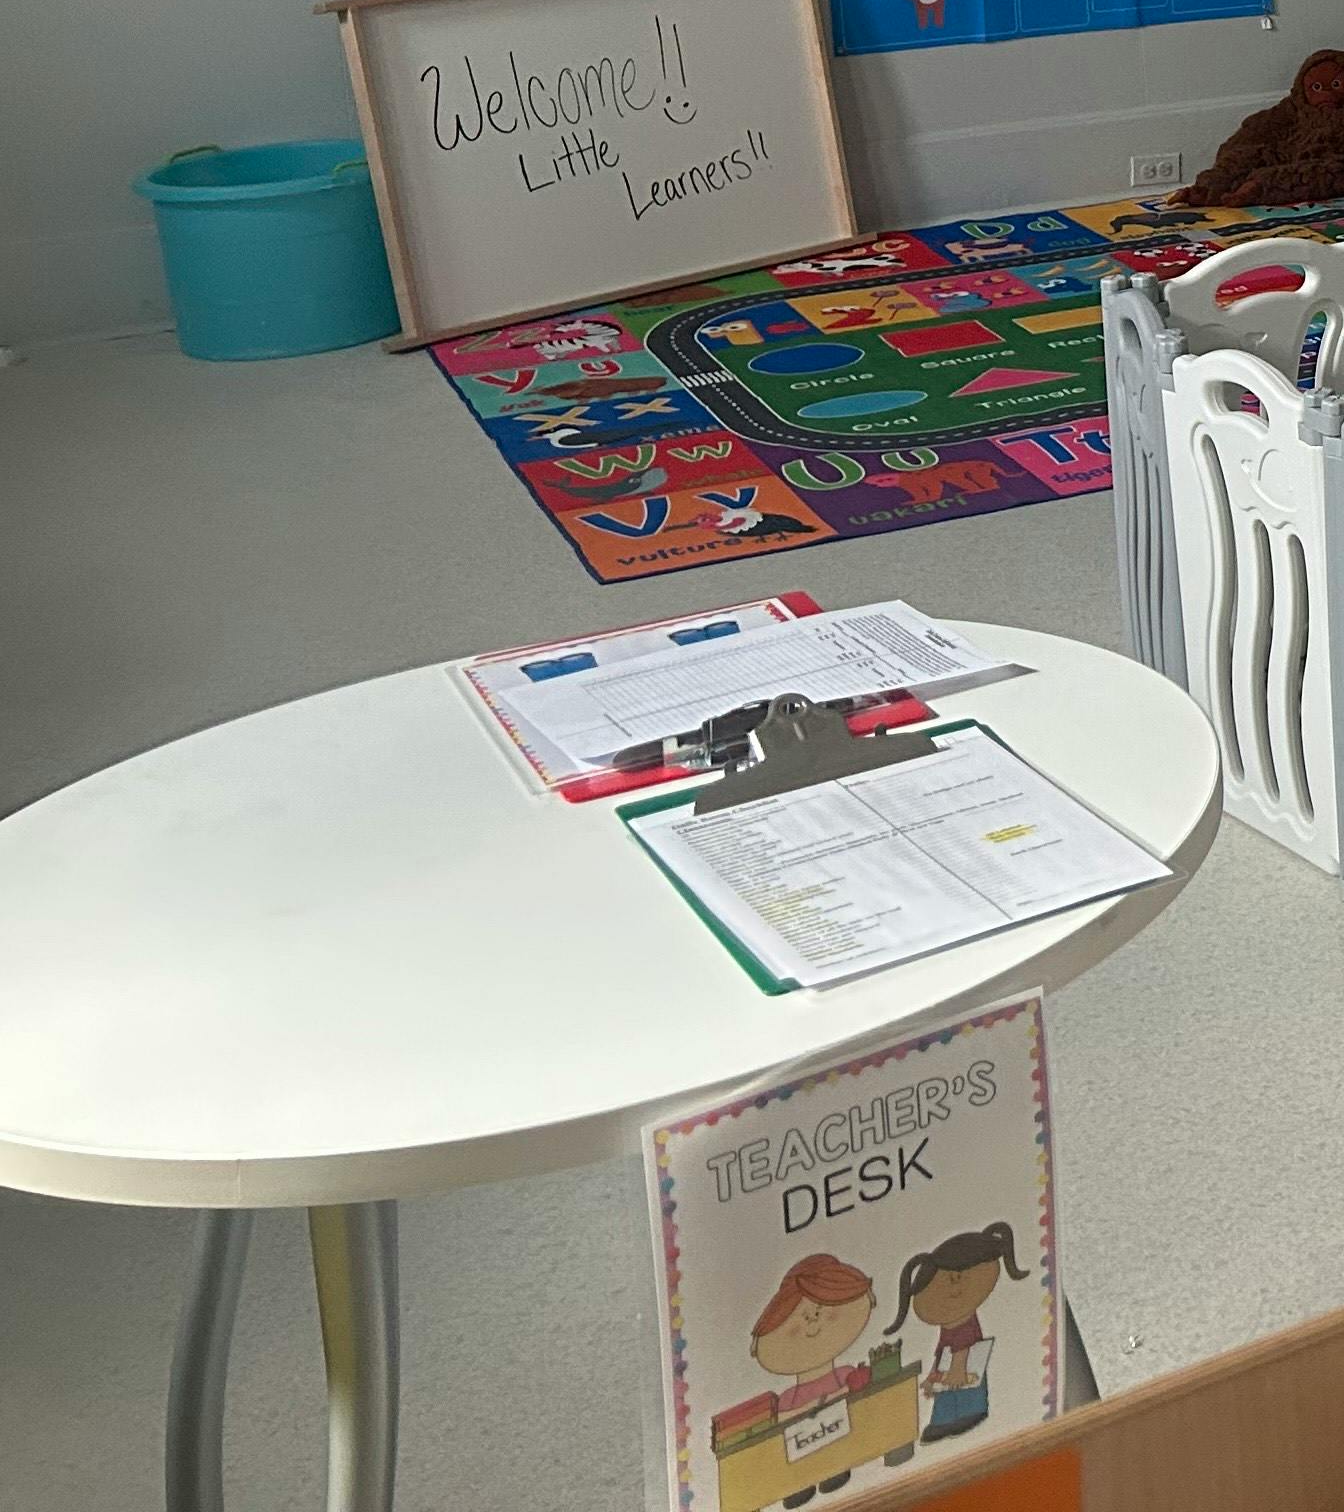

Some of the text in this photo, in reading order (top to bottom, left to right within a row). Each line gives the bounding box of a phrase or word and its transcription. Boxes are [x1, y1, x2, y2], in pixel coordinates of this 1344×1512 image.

[518, 129, 619, 193] Little
[623, 130, 774, 221] Learners!!
[961, 216, 1068, 241] D d
[920, 349, 1016, 369] Square
[790, 372, 873, 390] Circle
[977, 387, 1087, 409] Triangle
[512, 397, 681, 433] X x
[852, 416, 918, 431] Oval
[553, 441, 656, 479] W
[666, 441, 732, 462] w
[995, 425, 1076, 465] T
[781, 452, 866, 489] U
[881, 448, 939, 471] u
[576, 486, 760, 538] V v
[617, 537, 745, 566] vulture
[707, 1059, 998, 1203] TEACHER'S
[782, 1137, 934, 1234] DESK
